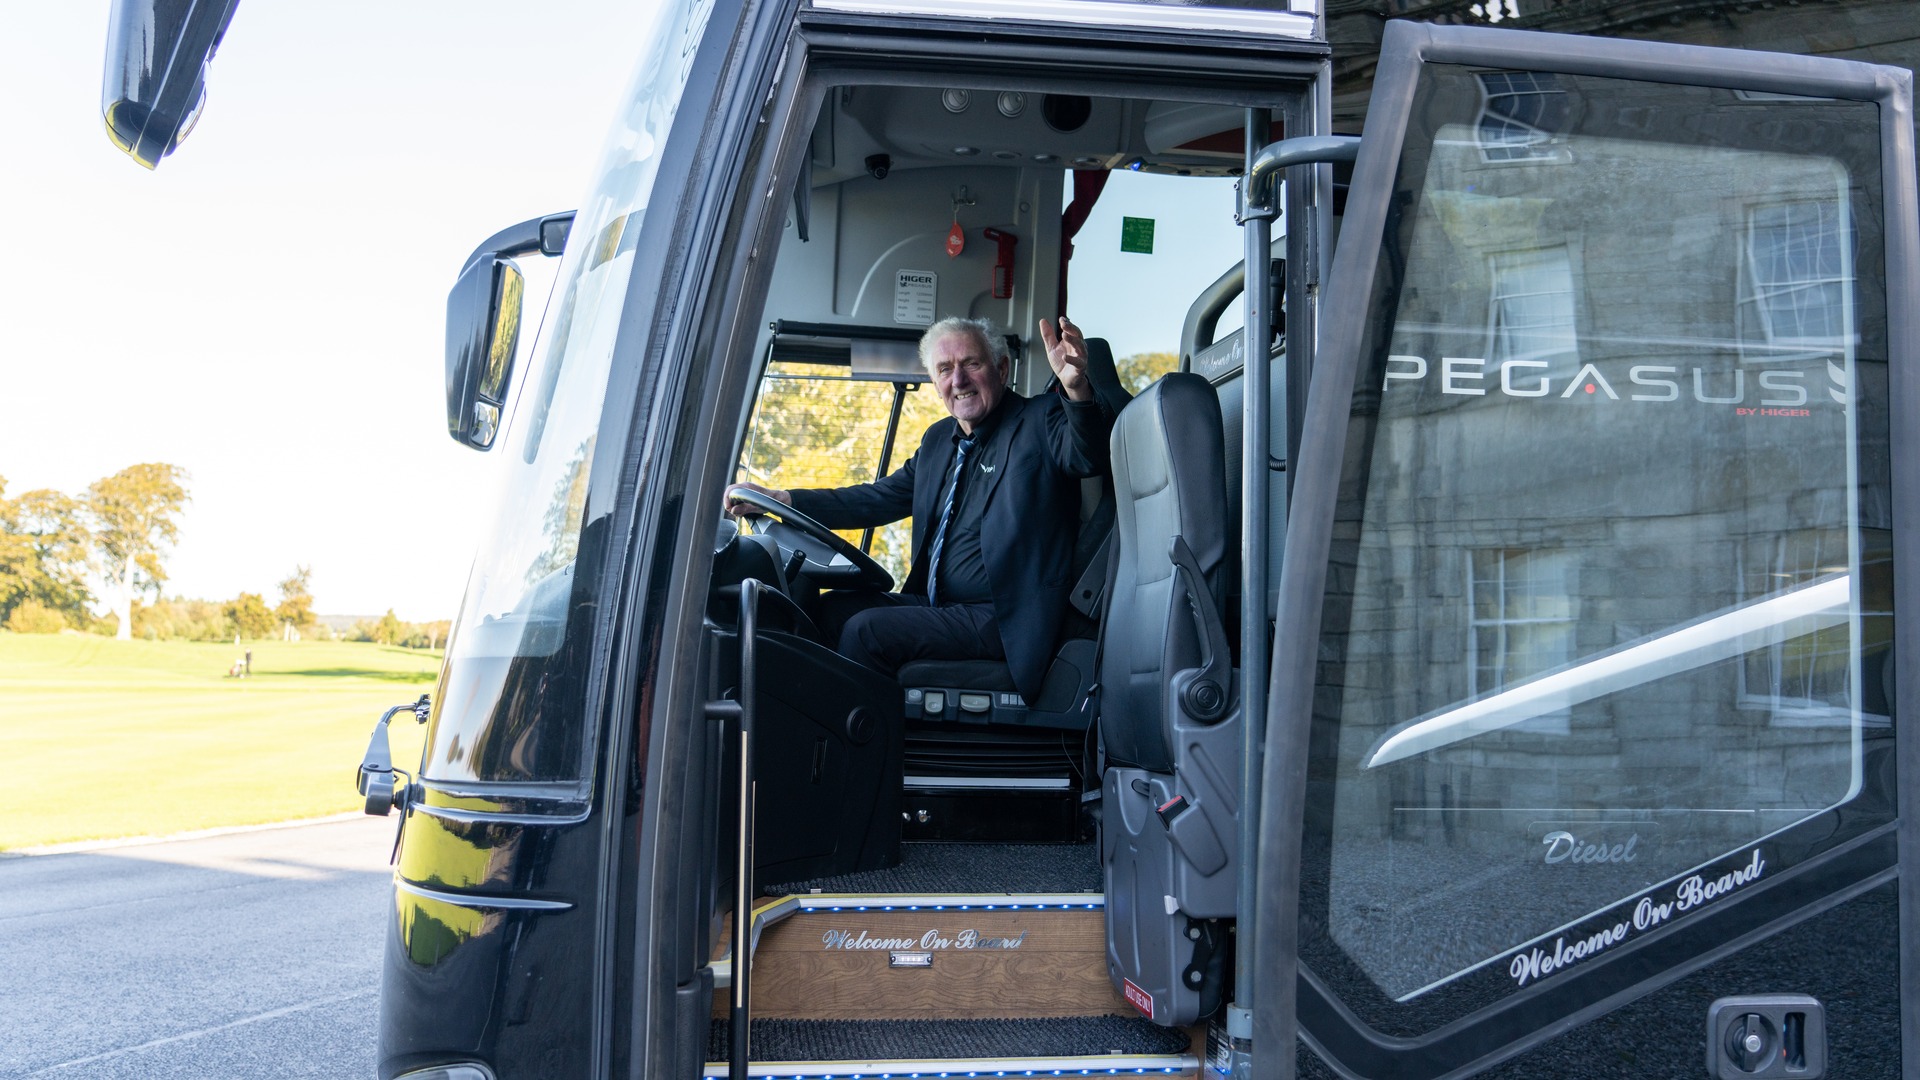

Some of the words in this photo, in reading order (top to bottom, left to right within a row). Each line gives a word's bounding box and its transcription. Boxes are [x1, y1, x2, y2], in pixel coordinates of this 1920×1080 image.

[900, 274, 932, 284] HIGER
[1382, 354, 1807, 407] PEGASUS
[1736, 407, 1757, 416] BY
[1760, 408, 1811, 417] HIGER
[1542, 830, 1638, 864] Diesel
[1509, 920, 1630, 986] Welcome
[1633, 897, 1674, 930] On
[1676, 848, 1765, 911] Board
[822, 928, 917, 950] Welcome
[920, 928, 953, 950] On
[955, 928, 1028, 950] Board
